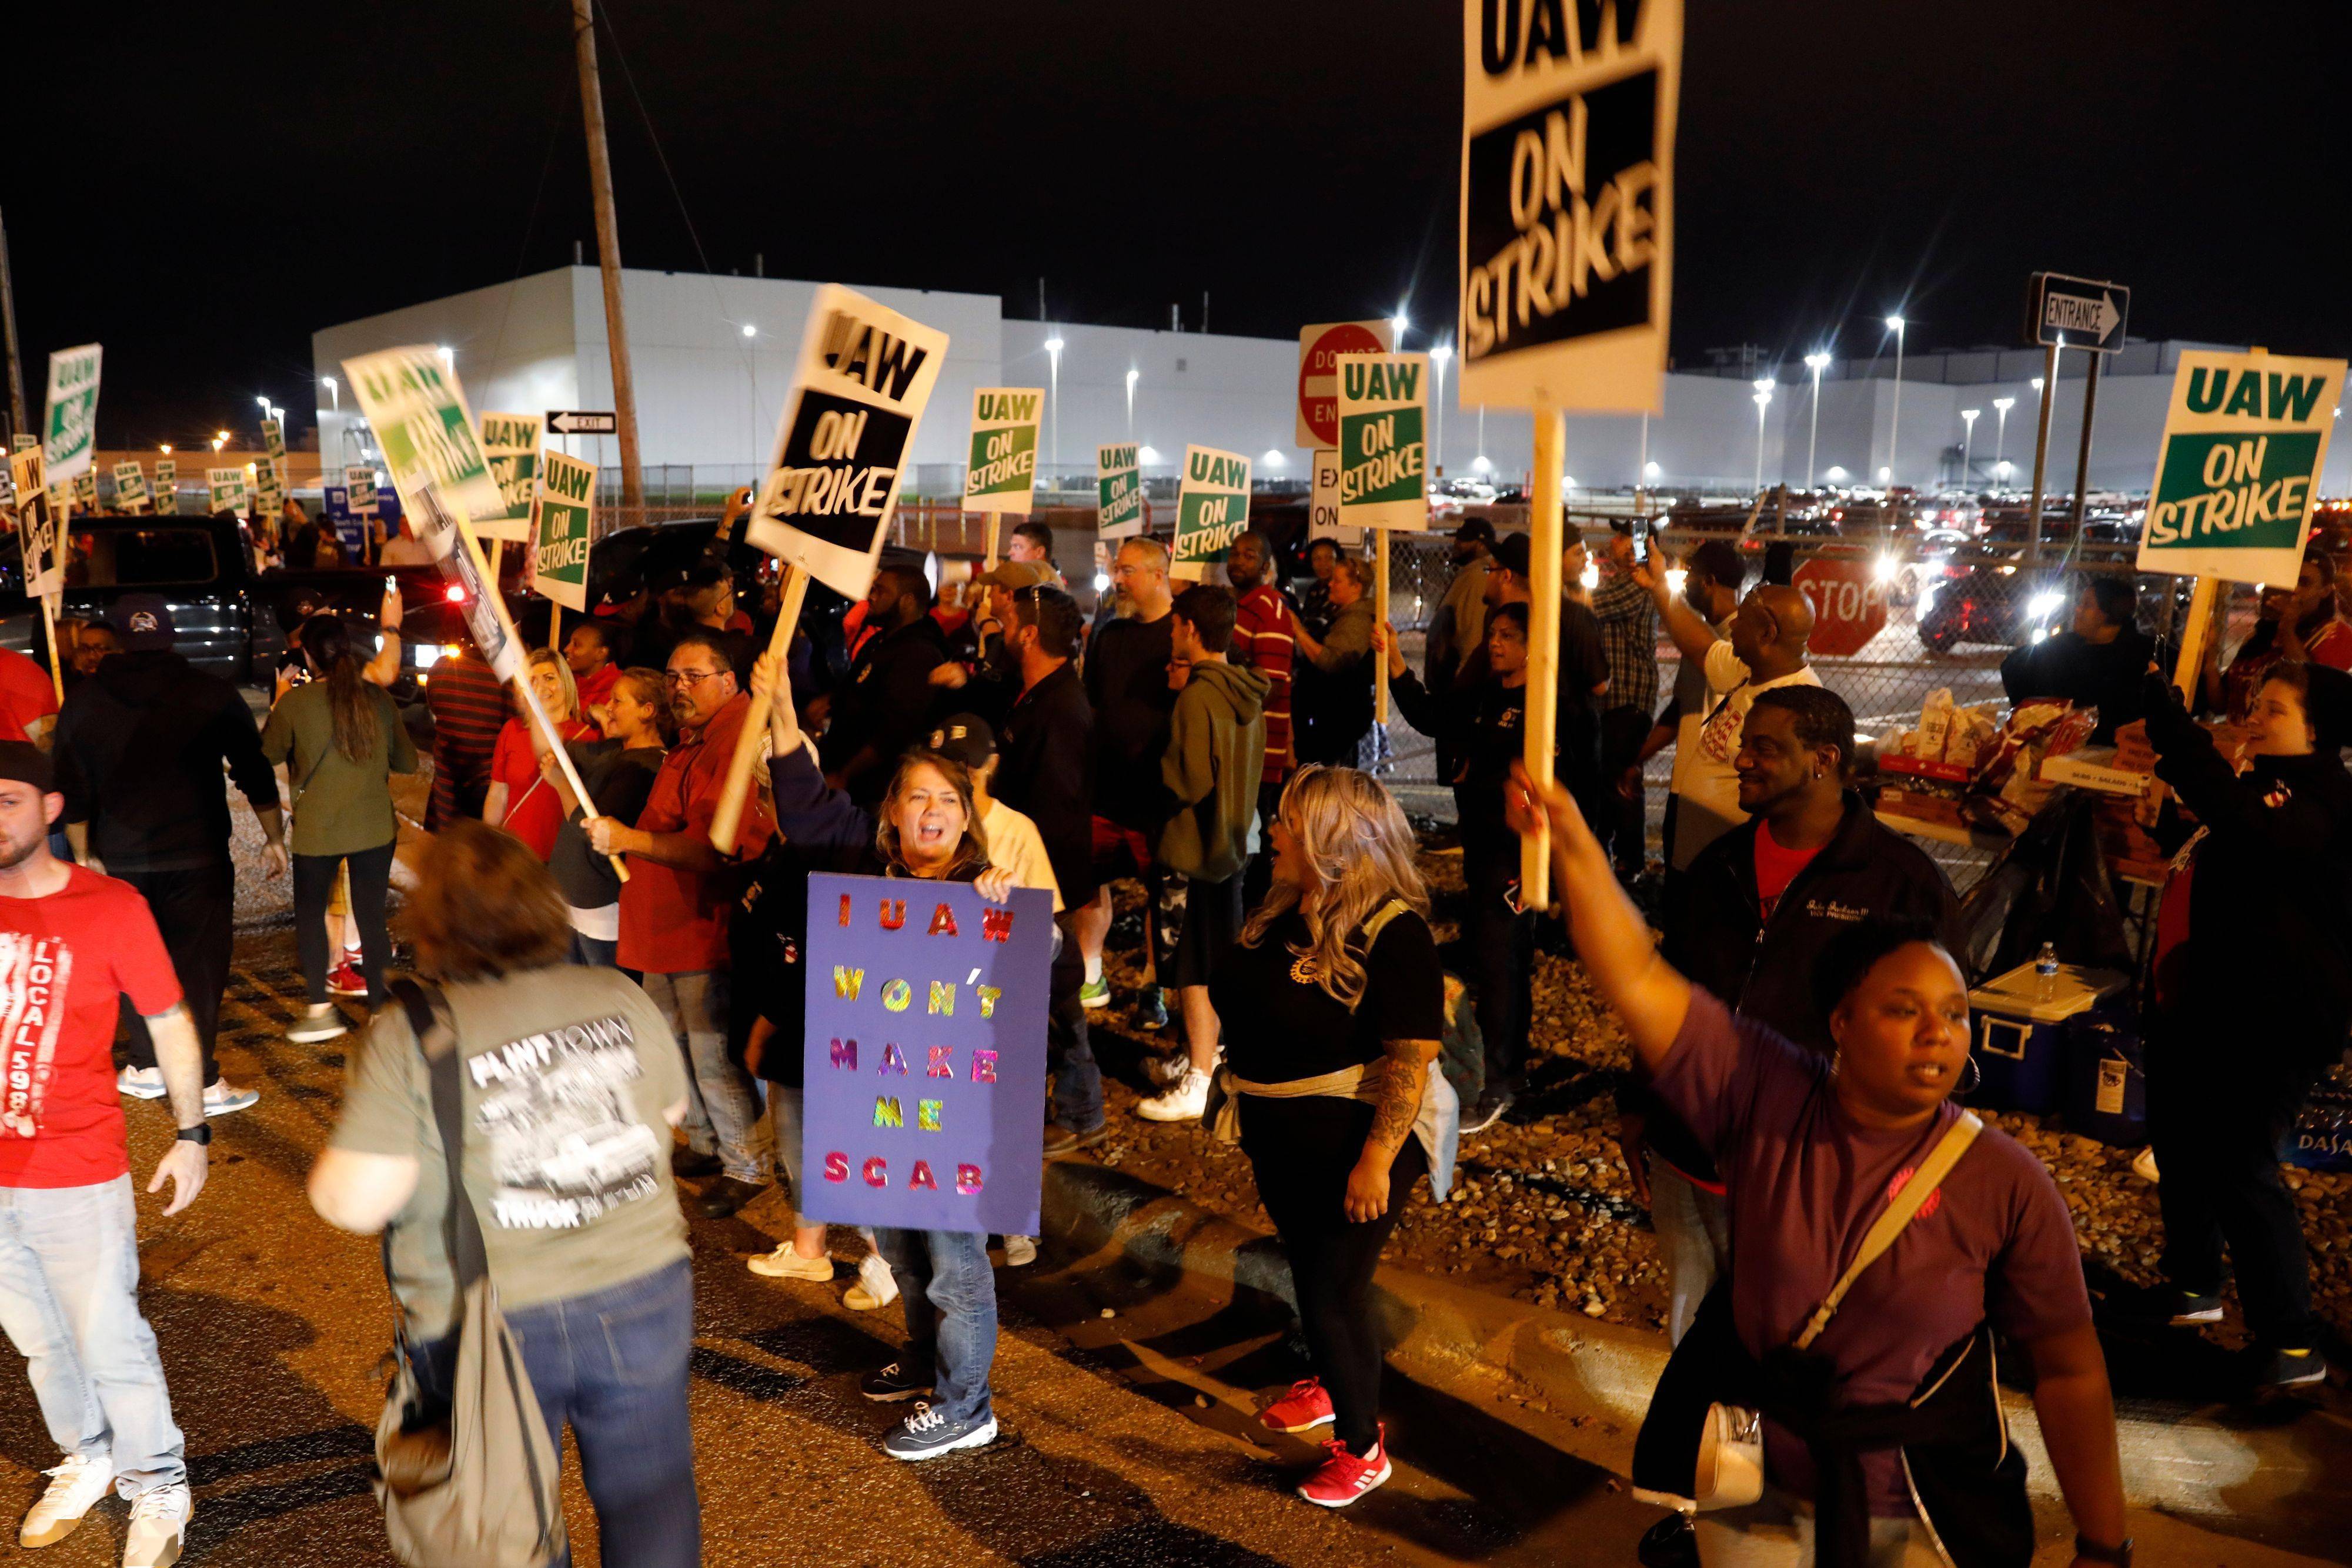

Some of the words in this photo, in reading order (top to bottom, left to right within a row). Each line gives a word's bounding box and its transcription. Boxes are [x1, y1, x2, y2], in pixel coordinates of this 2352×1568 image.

[1481, 0, 1645, 75] UAW
[1510, 94, 1588, 232] ON
[1468, 160, 1658, 359] STRIKE
[2048, 297, 2102, 330] ENTRANCE
[822, 309, 928, 403] UAW
[1315, 351, 1337, 369] DO
[1345, 363, 1419, 400] UAW
[2186, 367, 2327, 423] UAW
[577, 416, 600, 429] EXIT
[978, 394, 1038, 421] UAW
[485, 420, 537, 449] UAW
[809, 410, 868, 460] ON
[987, 430, 1013, 460] ON
[1361, 414, 1395, 456] ON
[213, 472, 240, 482] UAW
[967, 450, 1034, 494] STRIKE
[1101, 447, 1136, 469] UAW
[1190, 452, 1247, 489] UAW
[1321, 469, 1338, 487] EX
[1342, 442, 1424, 502] STRIKE
[2203, 435, 2268, 489] ON
[547, 457, 592, 502] UAW
[766, 464, 896, 516] STRIKE
[1111, 475, 1127, 499] ON
[552, 509, 571, 540] ON
[1100, 487, 1140, 525] STRIKE
[1199, 497, 1229, 526] ON
[1315, 506, 1338, 526] ON
[2150, 475, 2310, 546] STRIKE
[538, 537, 587, 573] STRIKE
[1799, 579, 1882, 622] STOP
[838, 893, 852, 927] I
[880, 898, 1015, 943] UAW
[15, 941, 54, 1047] LOCAL
[833, 964, 1002, 1019] WON'T
[830, 1037, 998, 1083] MAKE
[873, 1096, 943, 1132] ME
[2298, 1134, 2352, 1156] DASA
[824, 1150, 984, 1195] SCAB
